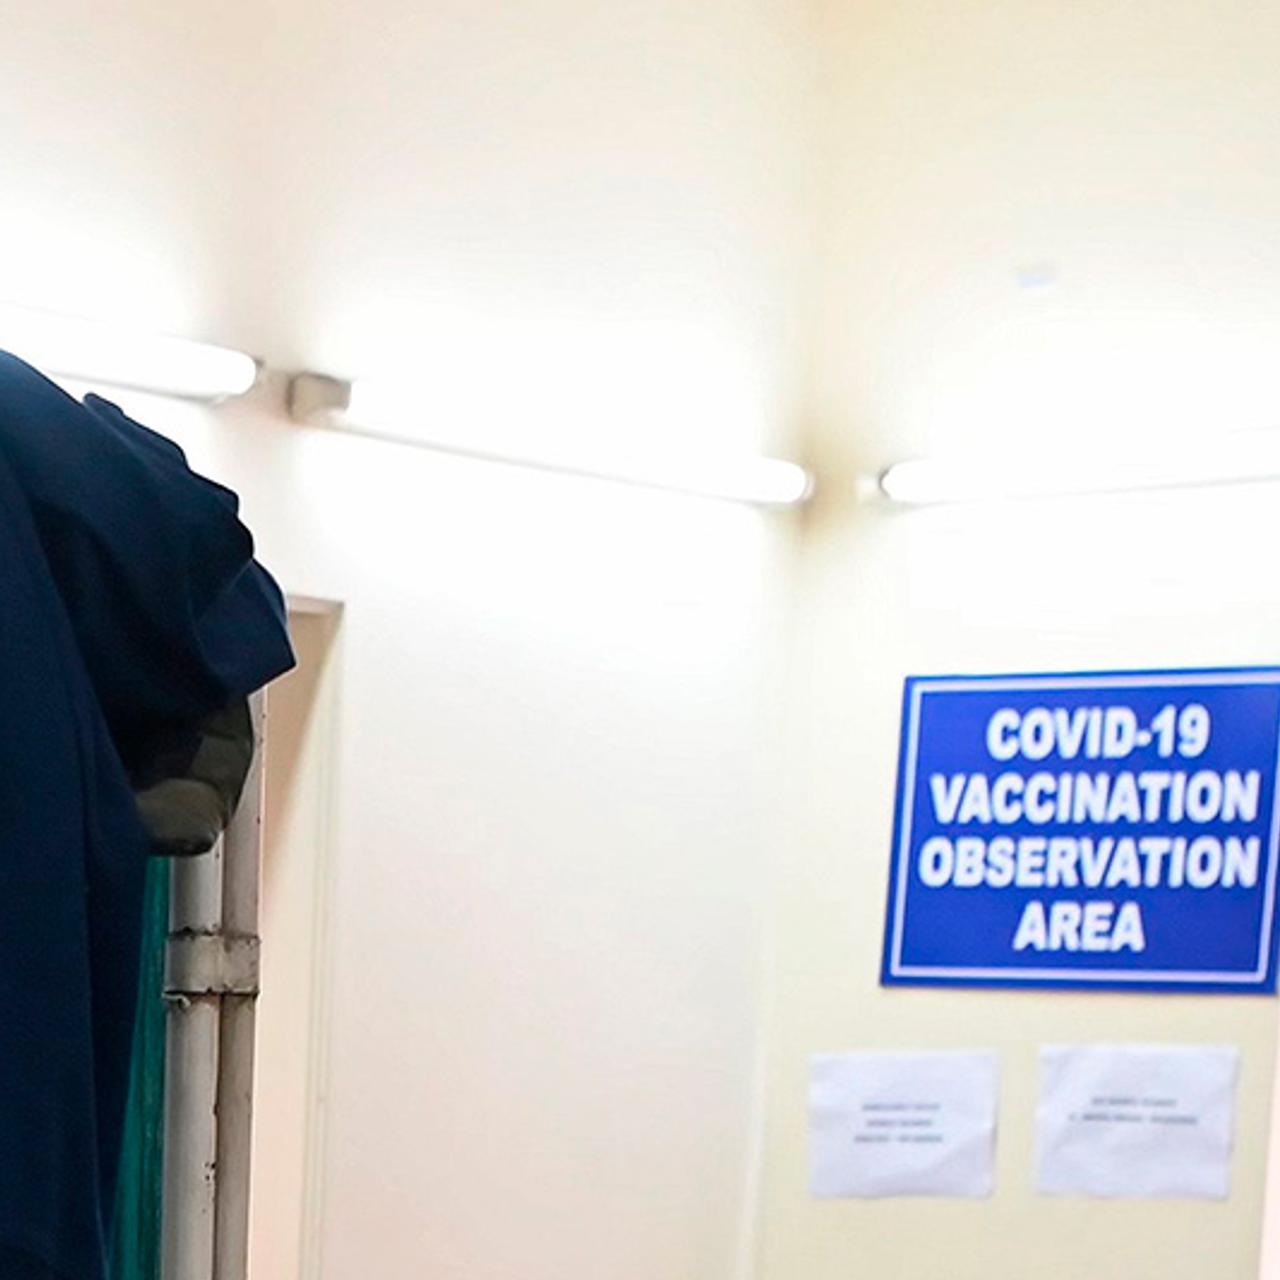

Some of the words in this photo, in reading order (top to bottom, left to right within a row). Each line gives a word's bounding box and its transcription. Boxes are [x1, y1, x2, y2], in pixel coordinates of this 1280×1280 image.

[988, 704, 1210, 760] COVID-19
[930, 770, 1261, 824] VACCINATION
[919, 836, 1261, 889] OBSERVATION
[1013, 900, 1146, 952] AREA
